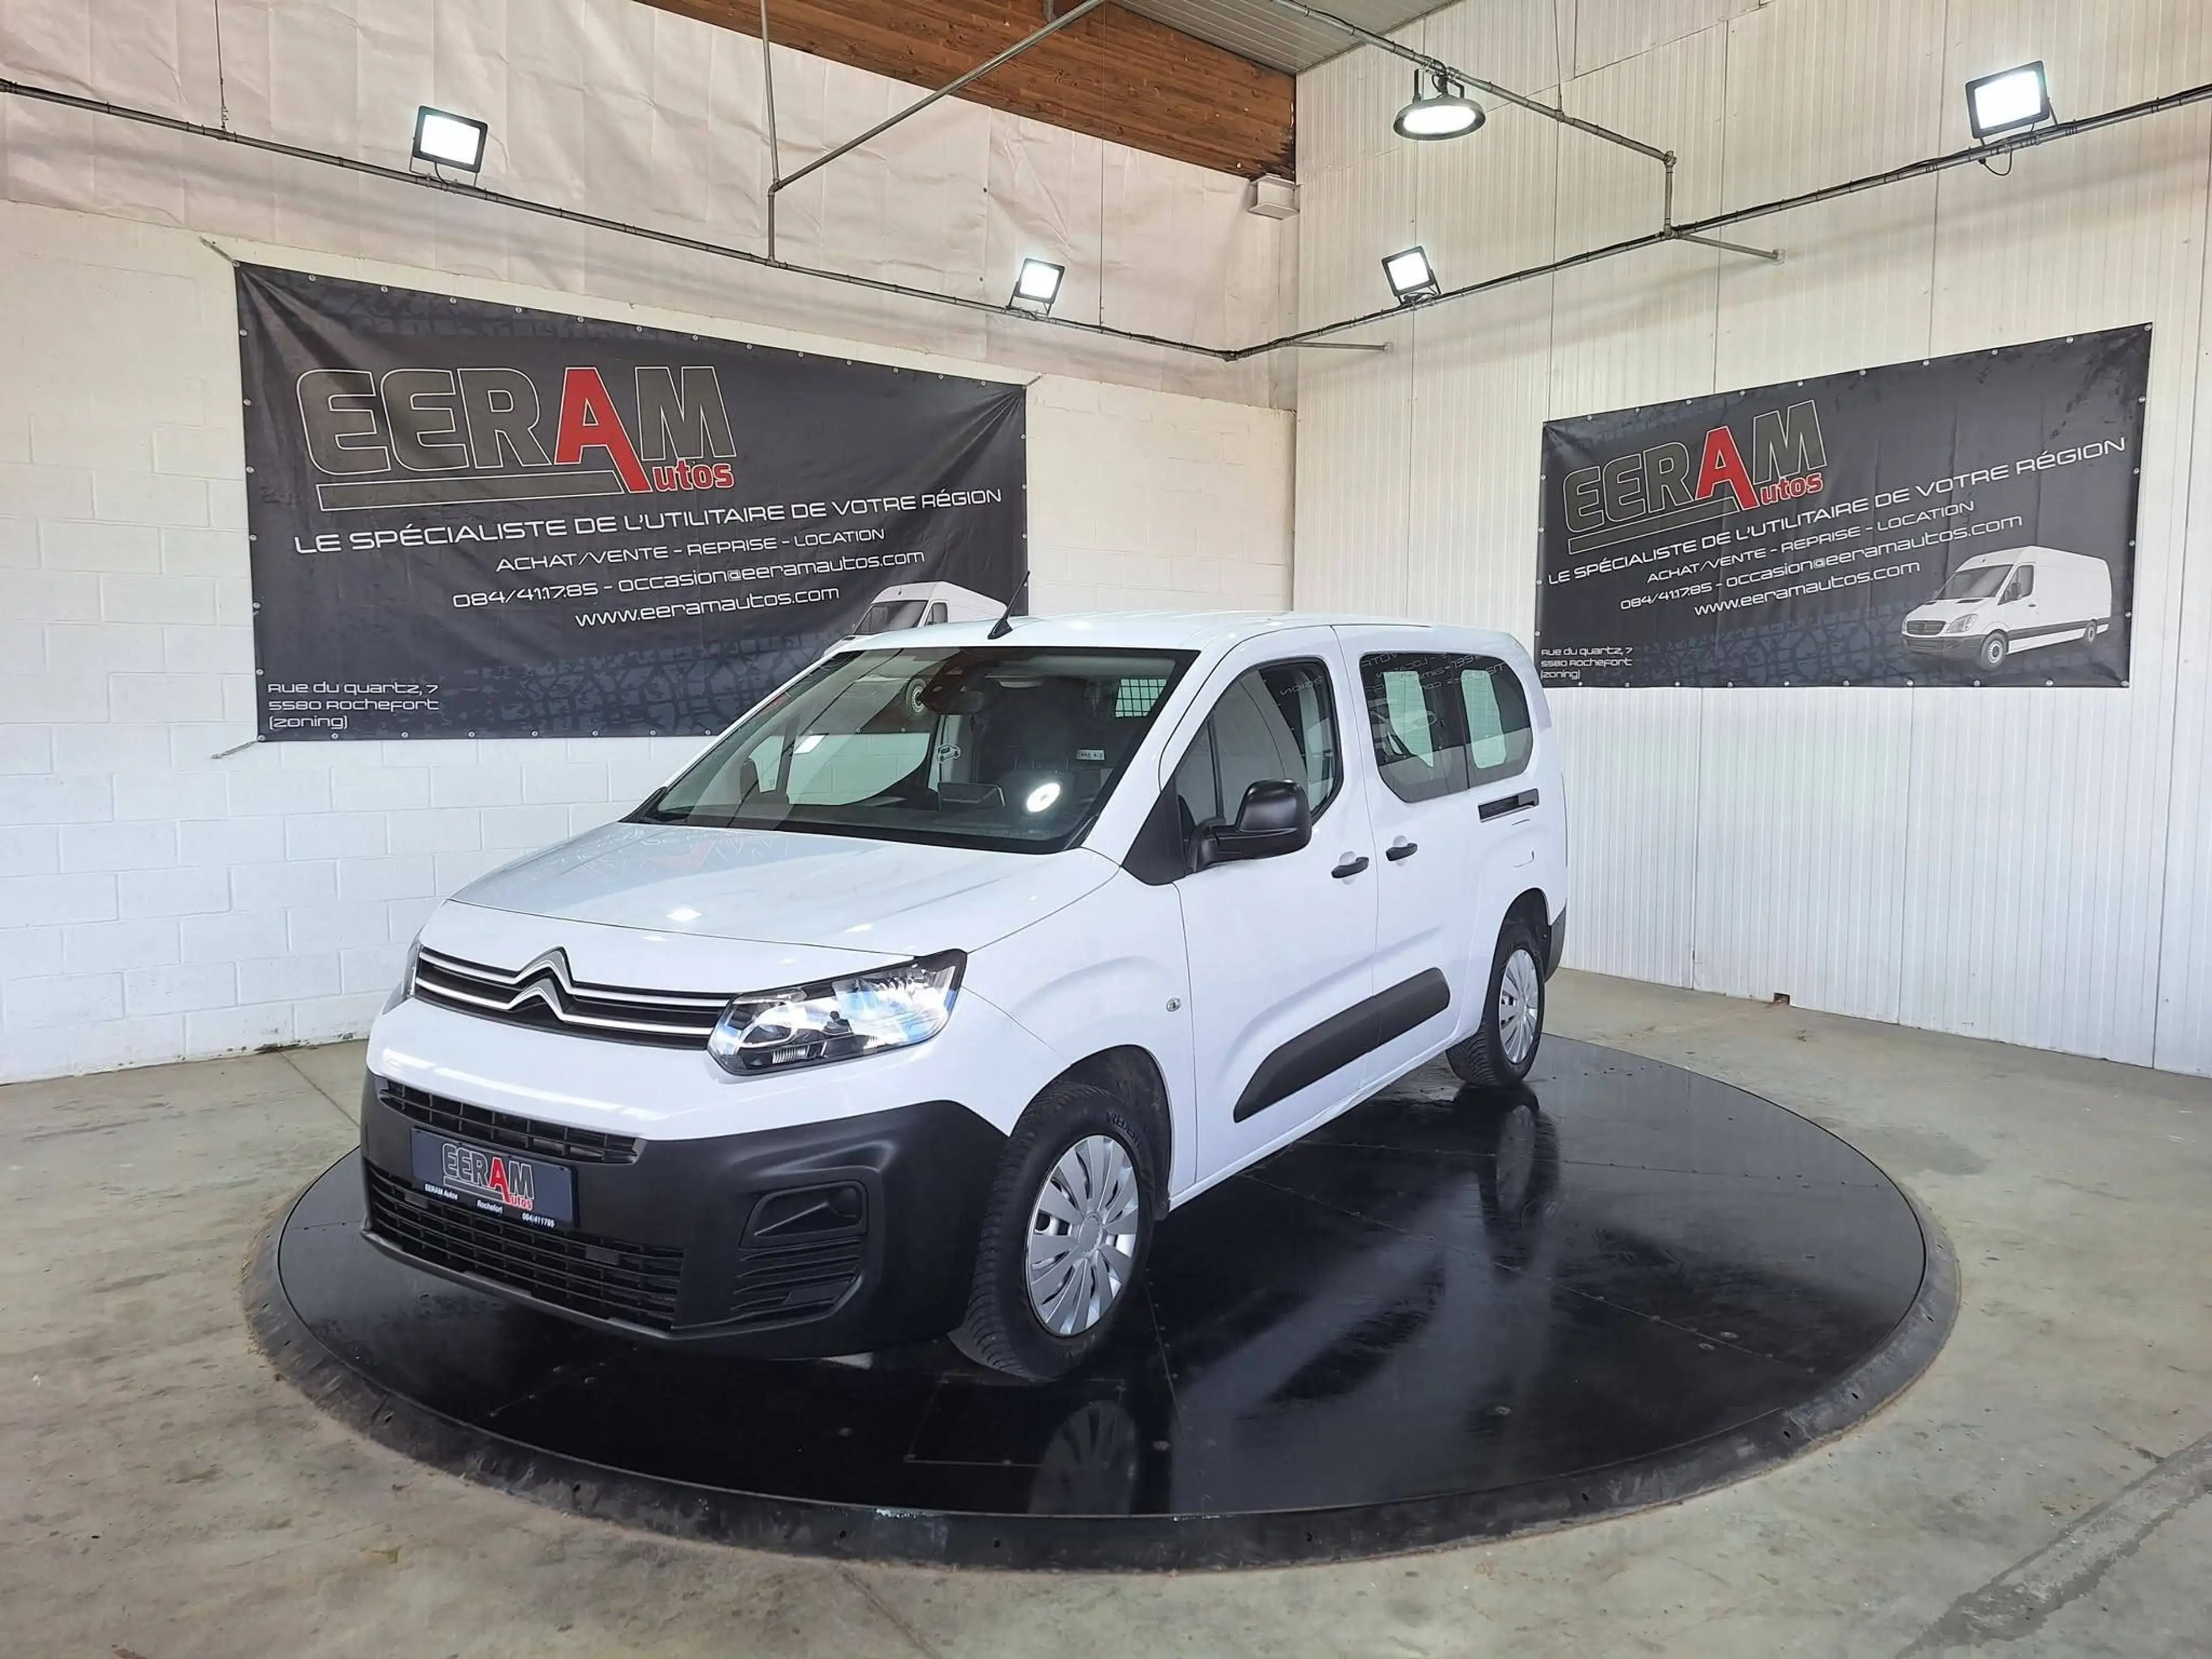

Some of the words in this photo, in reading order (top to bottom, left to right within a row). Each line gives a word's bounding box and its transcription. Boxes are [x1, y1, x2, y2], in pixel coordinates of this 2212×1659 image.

[296, 365, 737, 492] EERAM
[1562, 400, 1827, 533] EERAM
[294, 533, 342, 554] LE
[349, 519, 567, 550] SPÉCIALISTE
[575, 516, 618, 535] DE
[624, 505, 785, 531] L'UTILITAIRE
[791, 501, 827, 519] DE
[831, 494, 916, 516] VOTRE
[1548, 570, 1571, 585] LE
[1573, 539, 1698, 579] SPÉCIALISTE
[1702, 531, 1732, 550] DE
[1735, 497, 1869, 540] L'UTILITAIRE
[1875, 487, 1910, 509] DE
[1915, 464, 2010, 497] VOTRE
[1646, 547, 1767, 584] ACHAT/VENTE
[1781, 525, 1861, 553] REPRISE
[1877, 501, 1975, 532] LOCATION
[495, 546, 668, 573] ACHAT/VENTE
[687, 537, 777, 557] REPRISE
[794, 528, 885, 548] LOCATION
[618, 550, 925, 592] occasion@eeramautos.com
[1726, 514, 2023, 588] occasion@eeramautos.com
[575, 585, 839, 627] www.eeramautos.com
[1694, 560, 1921, 616] www.eeramautos.com
[1540, 669, 1581, 680] (zoning)
[1563, 647, 1577, 656] du
[268, 700, 321, 711] 5580
[326, 698, 439, 712] Rochefort
[313, 681, 339, 693] du
[344, 681, 423, 696] quartz,
[427, 684, 439, 694] 7
[268, 715, 347, 730] (zoning)
[442, 1143, 534, 1204] EERAM
